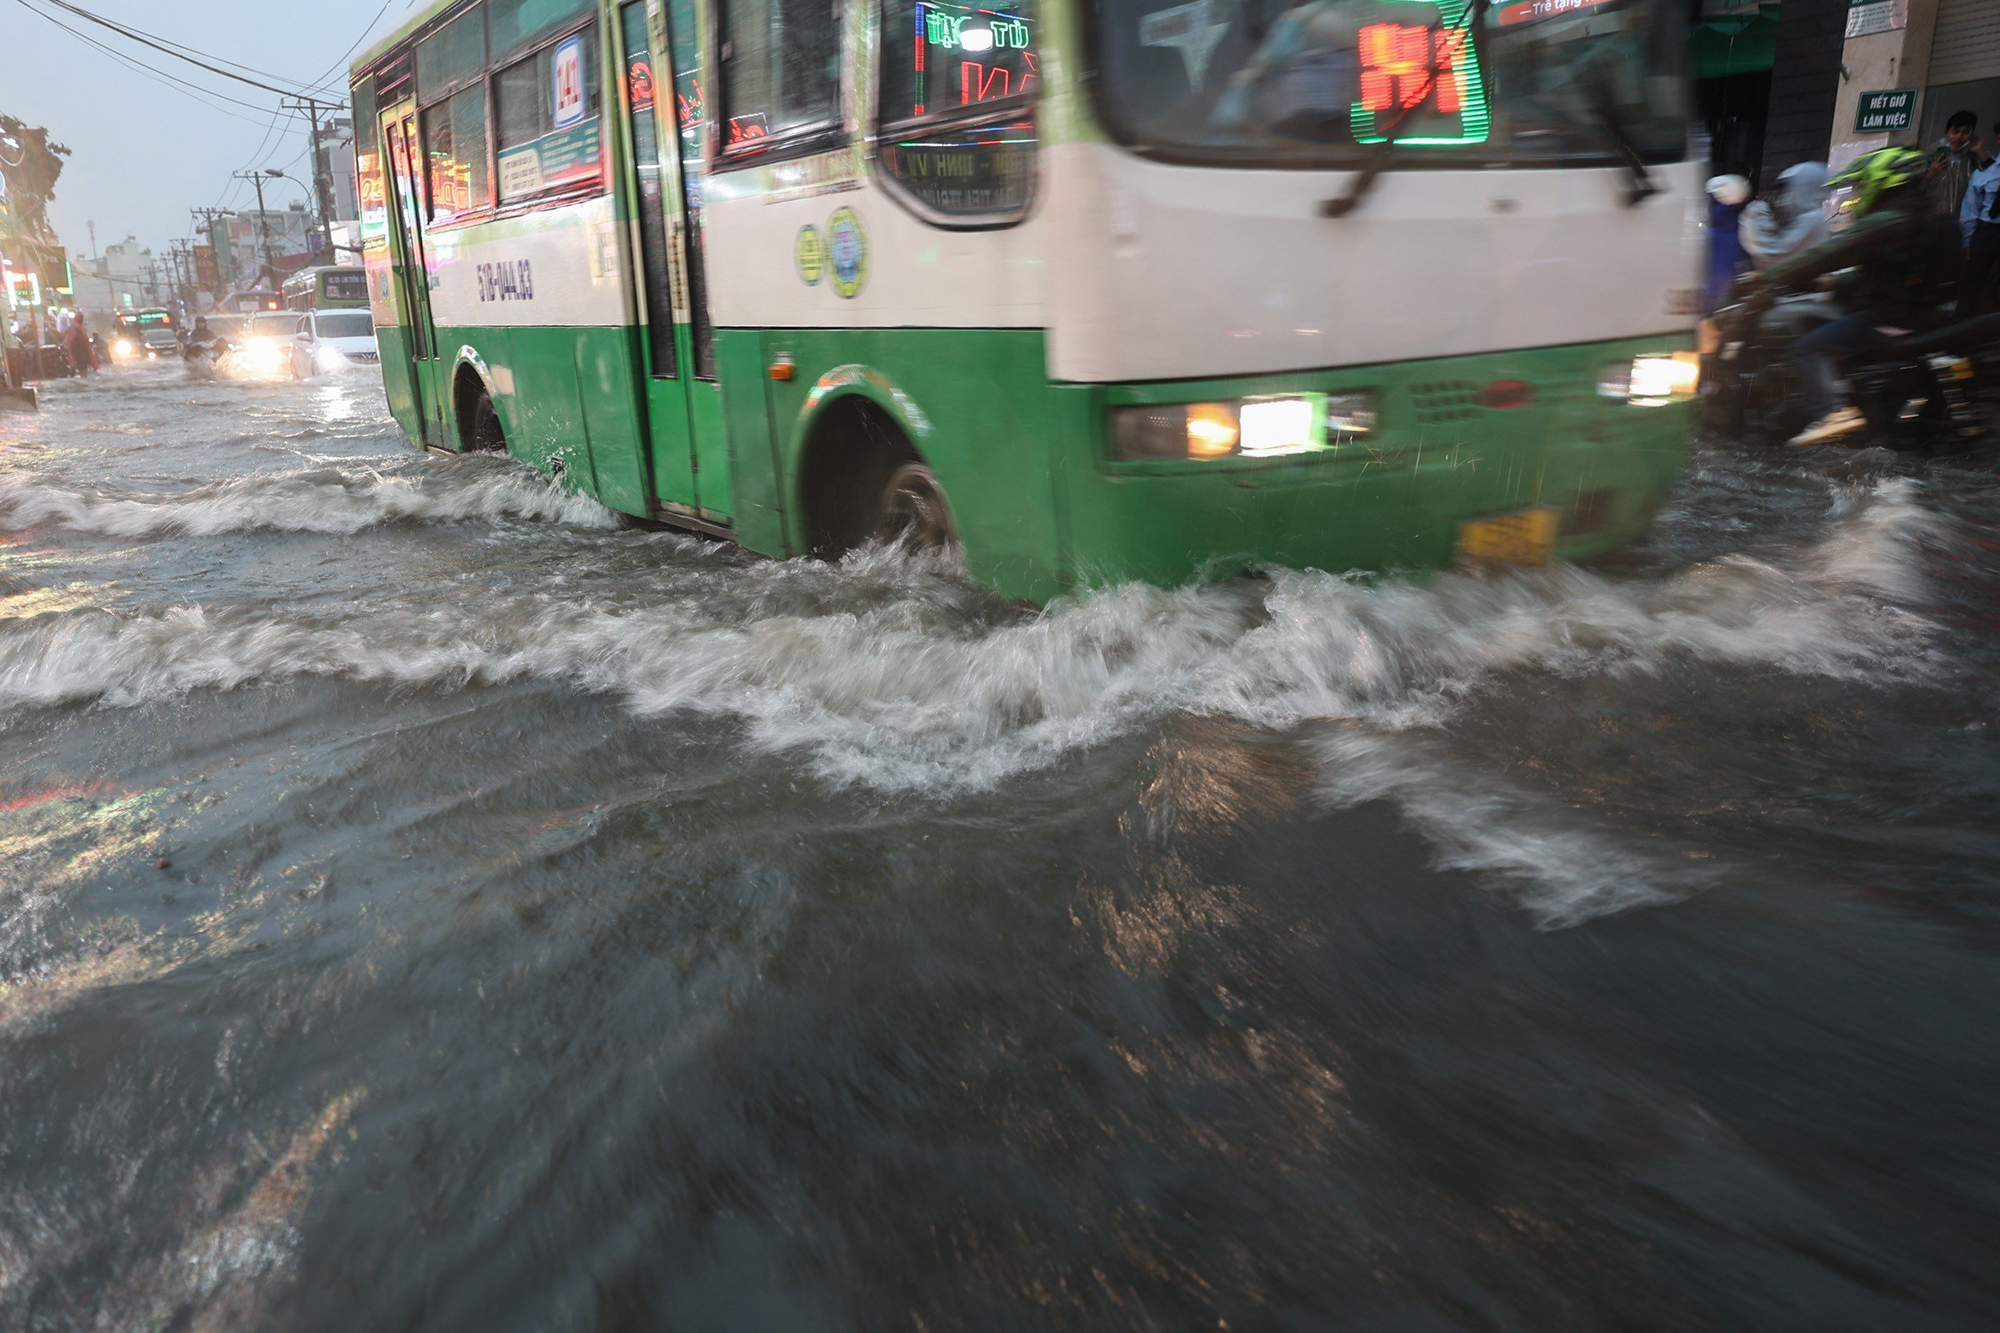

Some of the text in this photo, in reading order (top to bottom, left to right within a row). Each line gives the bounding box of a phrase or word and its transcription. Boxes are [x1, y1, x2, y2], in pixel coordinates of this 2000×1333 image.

[1870, 93, 1907, 109] HẾT GIỜ
[1863, 111, 1906, 128] LÀM VIỆC
